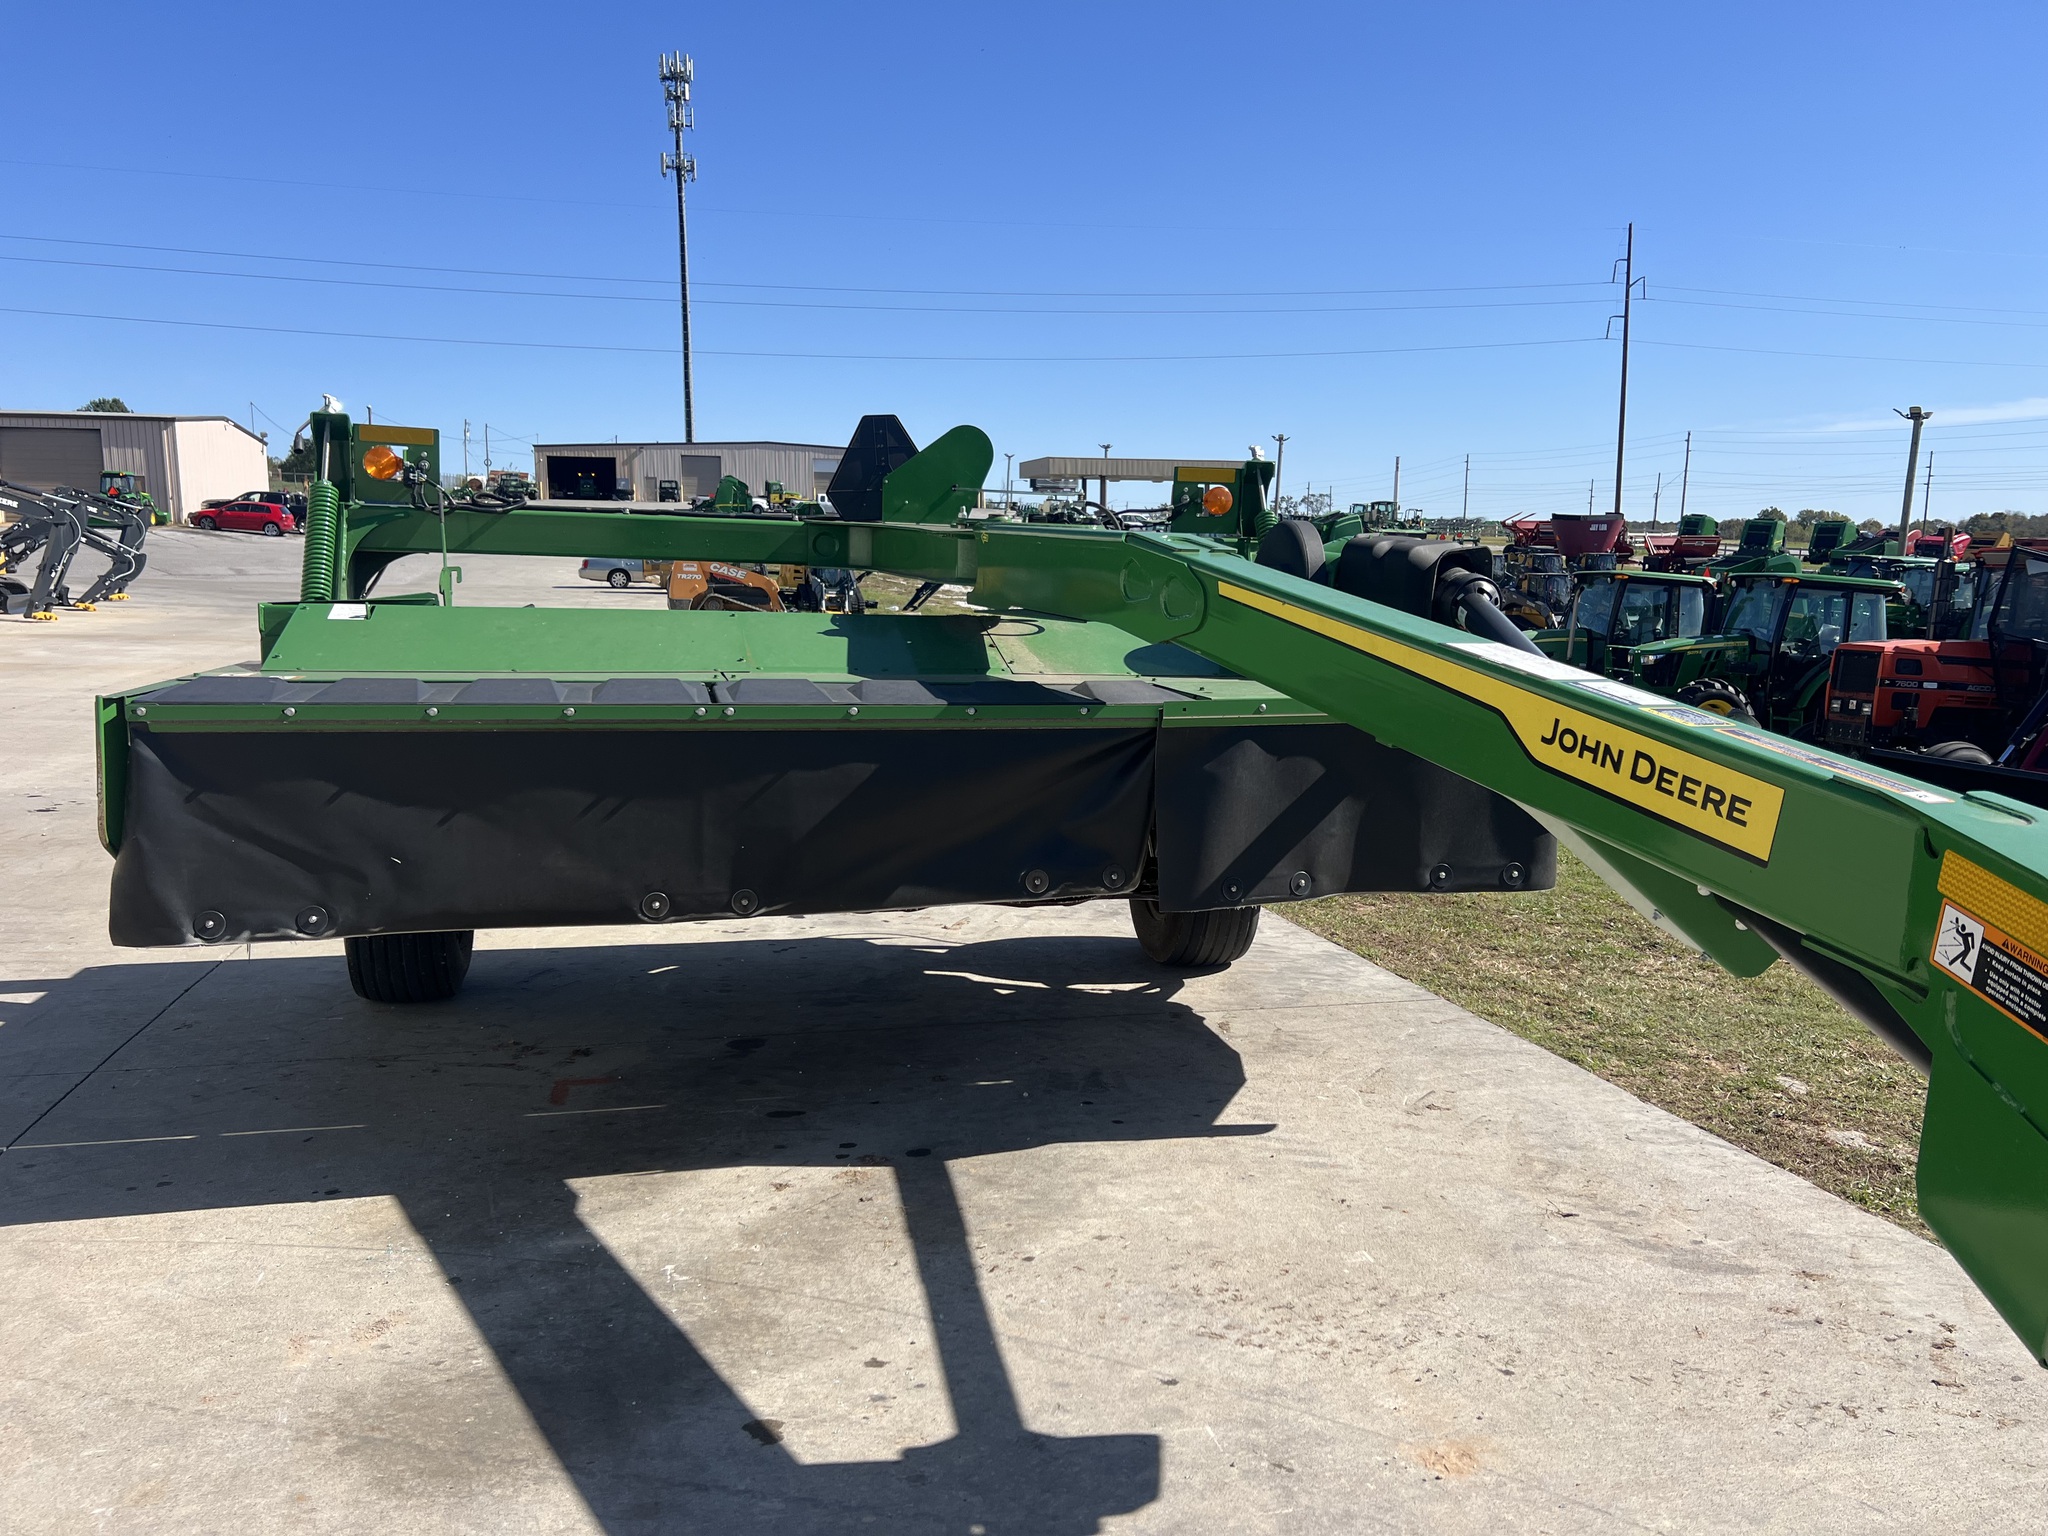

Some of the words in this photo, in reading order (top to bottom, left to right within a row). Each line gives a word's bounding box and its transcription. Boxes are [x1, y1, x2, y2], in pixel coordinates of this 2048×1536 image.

[709, 563, 747, 579] CASE
[1895, 680, 1919, 688] 7600
[1967, 684, 1991, 692] AGCO
[1541, 718, 1624, 775] JOHN
[1629, 750, 1752, 828] DEERE
[1981, 943, 1994, 955] AVOID
[2010, 961, 2022, 972] FROM
[2023, 969, 2042, 986] THROWN
[1992, 960, 2004, 972] Keep
[2004, 969, 2021, 983] curtain
[1985, 986, 2005, 1002] operator
[1987, 978, 2009, 997] equipped
[2008, 994, 2020, 1005] with
[2024, 1004, 2046, 1021] complete
[1989, 970, 1999, 981] Use
[1998, 978, 2010, 989] only
[2009, 985, 2020, 996] with
[2025, 994, 2041, 1009] tractor
